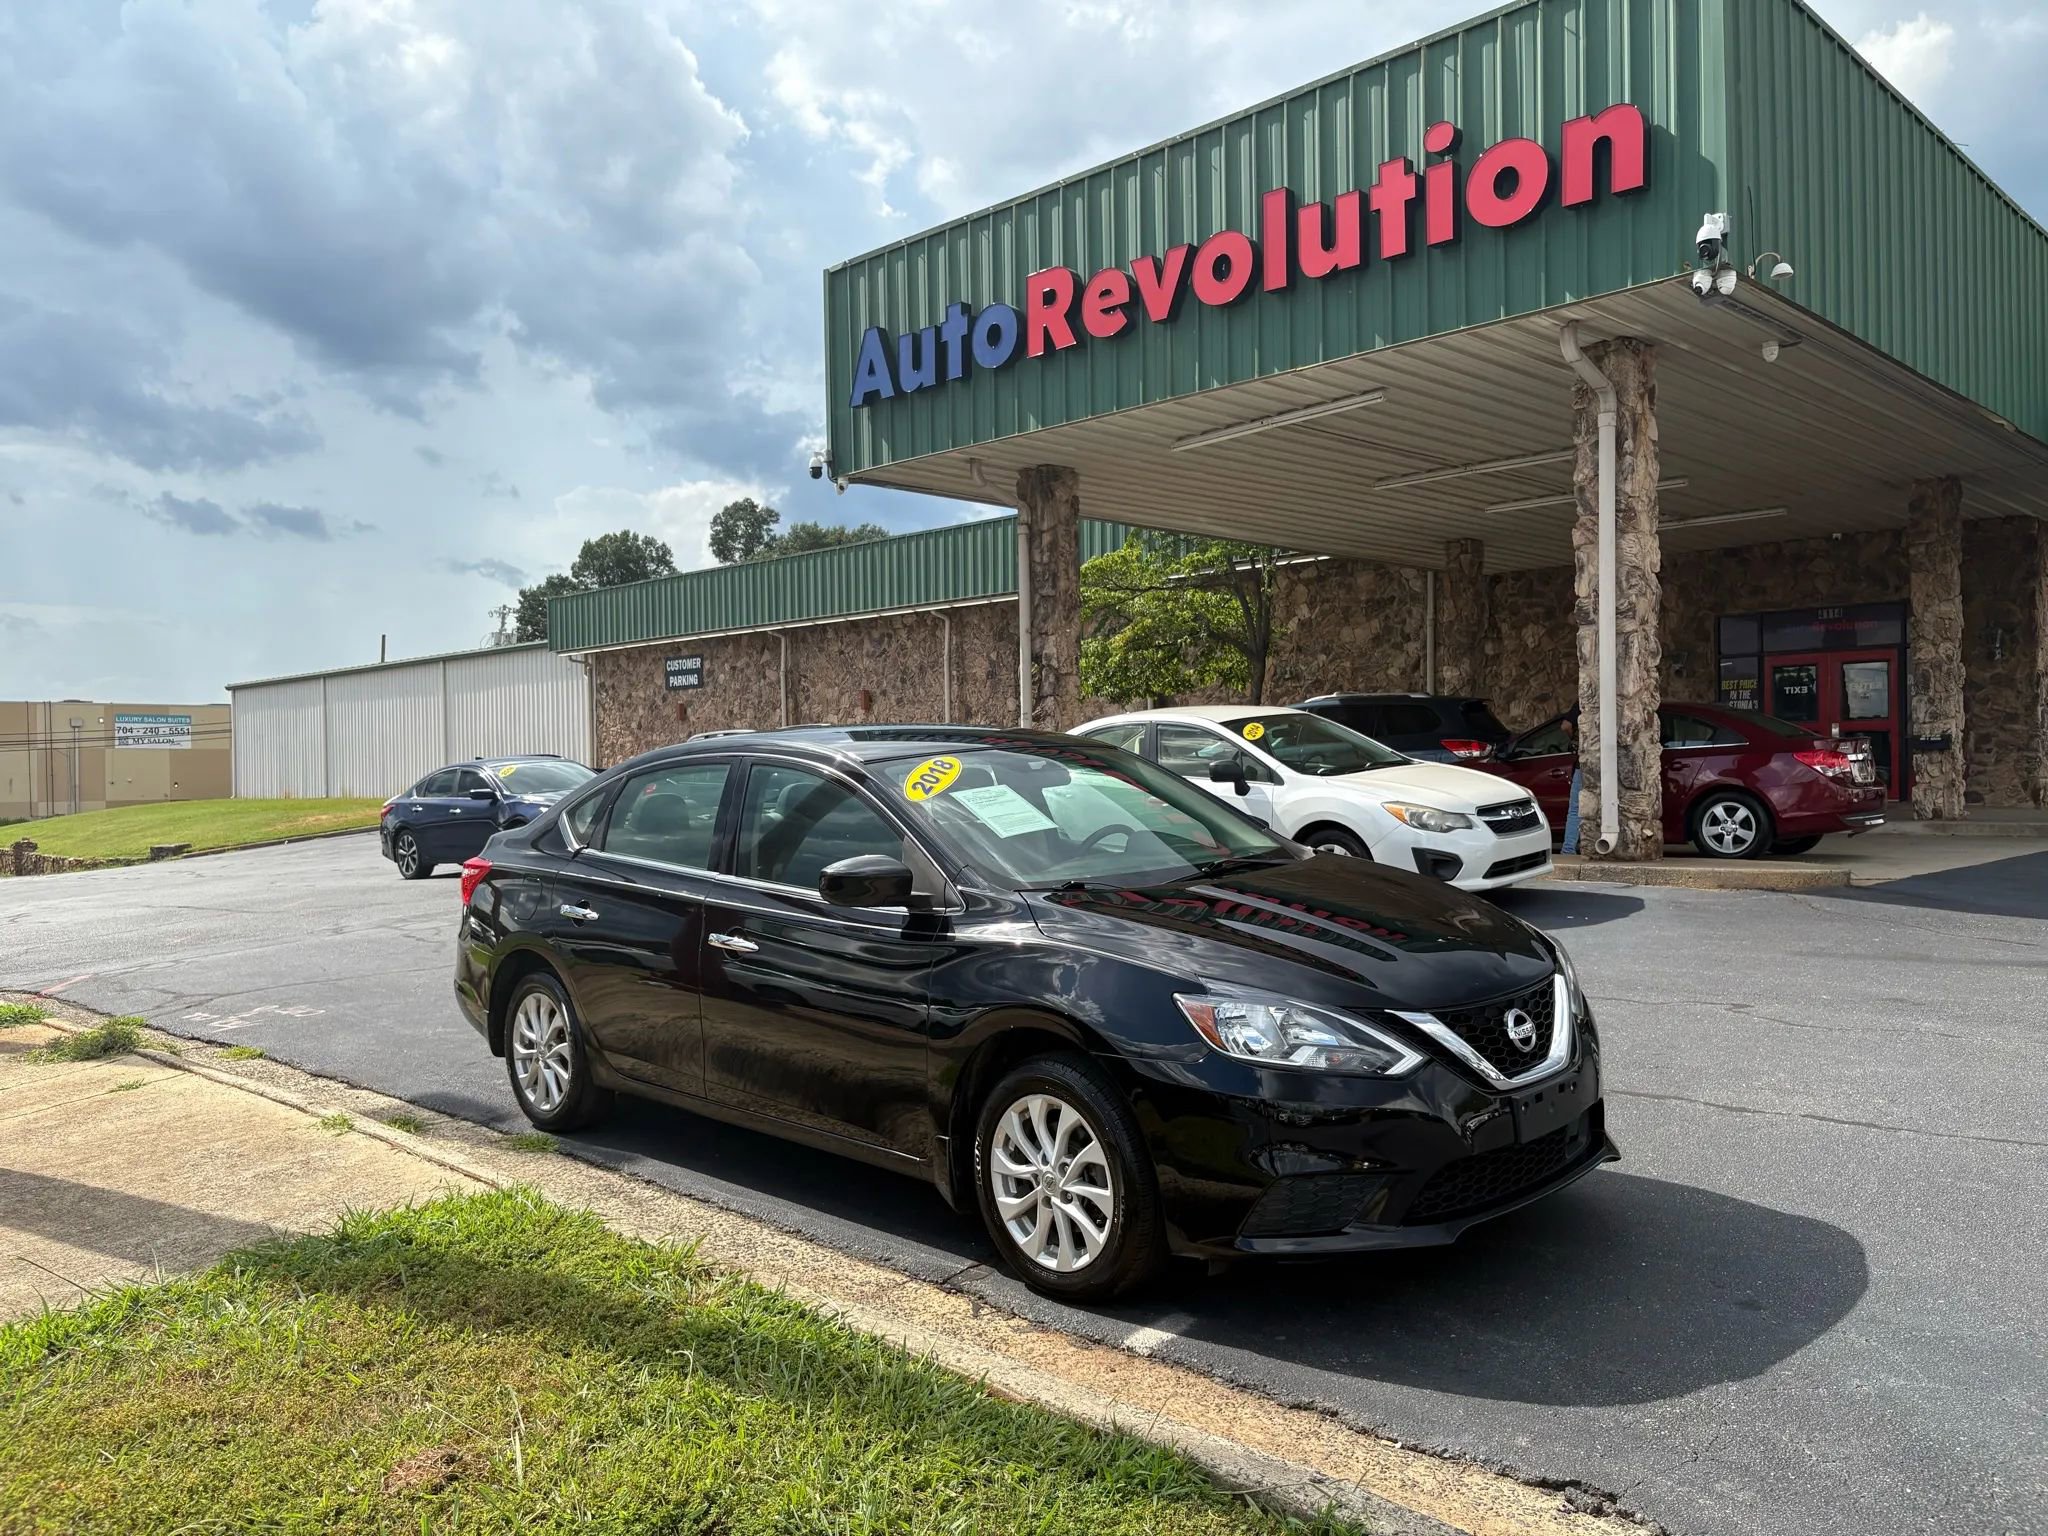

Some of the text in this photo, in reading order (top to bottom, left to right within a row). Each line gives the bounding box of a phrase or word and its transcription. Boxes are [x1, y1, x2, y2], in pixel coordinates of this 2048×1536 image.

[666, 657, 702, 672] CUSTOMER
[669, 673, 699, 687] PARKING
[1738, 689, 1751, 700] THE
[912, 759, 953, 795] 2018
